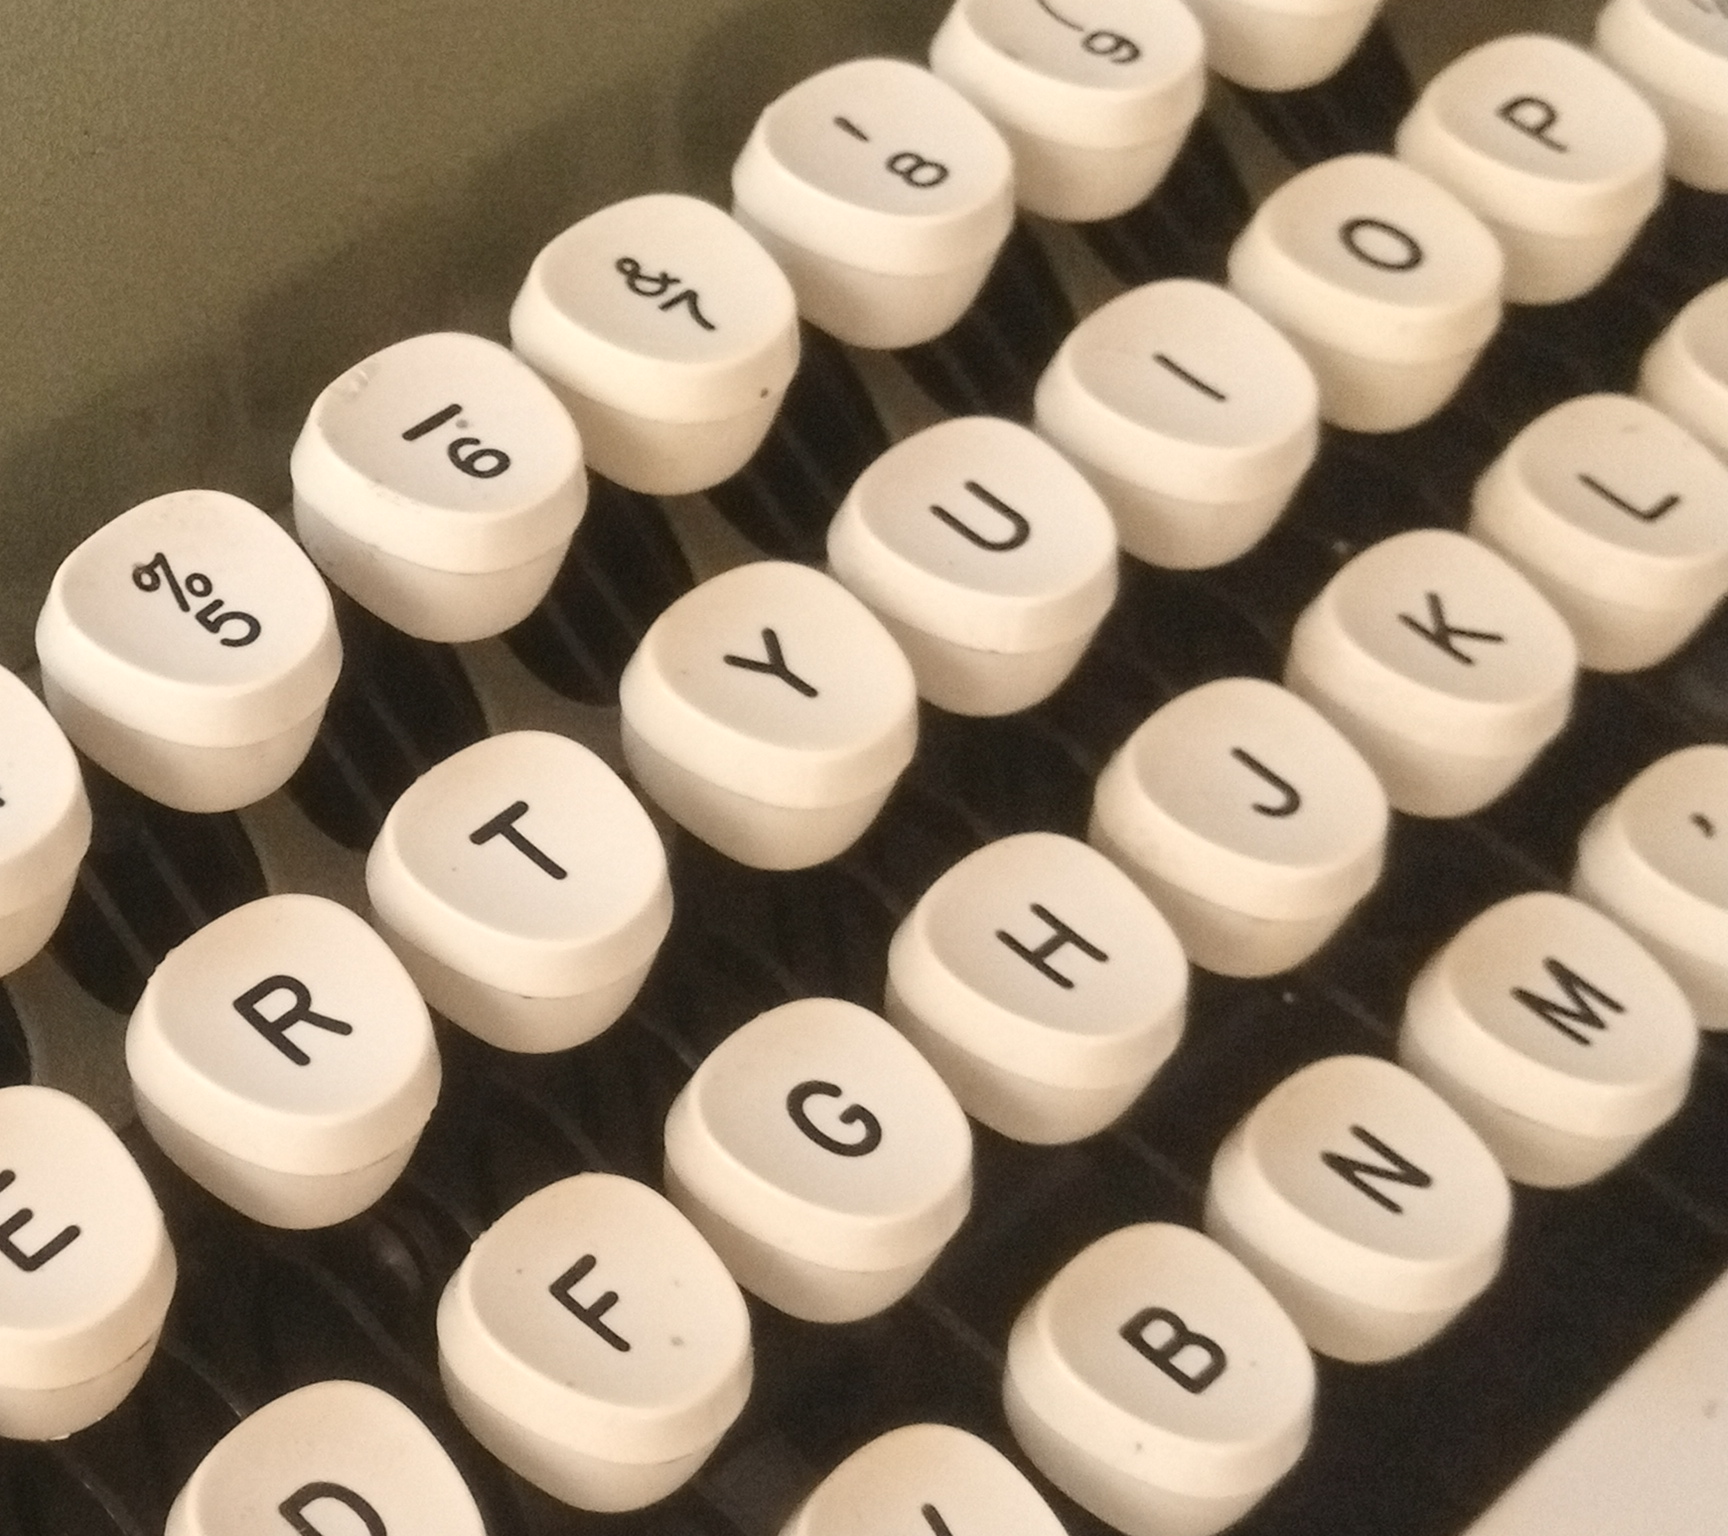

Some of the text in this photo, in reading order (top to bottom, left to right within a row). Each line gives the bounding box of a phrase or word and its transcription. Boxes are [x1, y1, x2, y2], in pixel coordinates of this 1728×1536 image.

[1081, 30, 1142, 65] 9
[1496, 95, 1567, 153] P
[885, 151, 950, 190] 8
[1338, 216, 1425, 273] O
[658, 288, 717, 332] 7
[446, 436, 512, 480] 6
[929, 480, 1032, 553] U
[1578, 473, 1682, 524] L
[194, 598, 262, 649] 5
[1397, 592, 1505, 667] K
[722, 627, 819, 699] Y
[1230, 747, 1302, 819] J
[468, 799, 569, 881] T
[995, 903, 1110, 991] H
[231, 973, 354, 1067] R
[1510, 957, 1626, 1047] M
[785, 1079, 883, 1159] G
[1320, 1124, 1433, 1215] N
[548, 1253, 632, 1353] F
[1118, 1306, 1228, 1395] B
